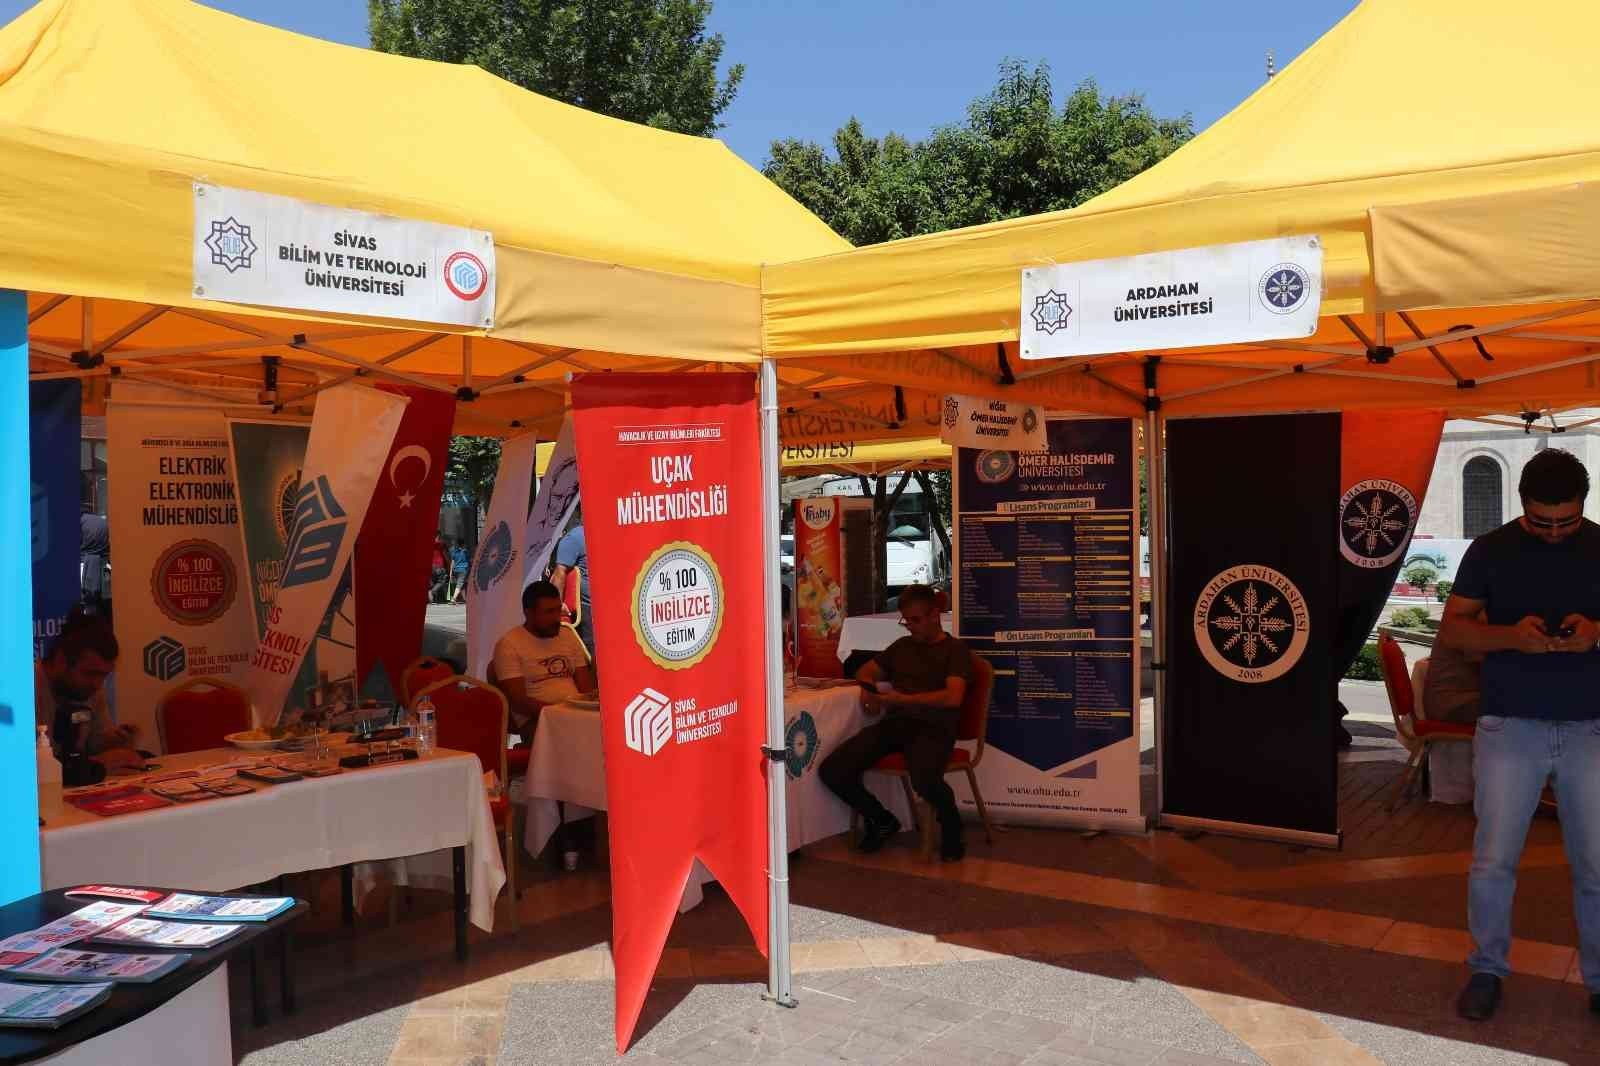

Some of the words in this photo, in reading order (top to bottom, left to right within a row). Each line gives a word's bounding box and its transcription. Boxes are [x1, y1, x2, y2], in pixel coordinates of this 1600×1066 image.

[334, 229, 376, 251] SİVAS
[279, 245, 321, 266] BİLİM
[324, 252, 345, 268] VE
[348, 256, 427, 279] TEKNOLOJİ
[305, 270, 404, 296] ÜNİVERSİTESİ
[1126, 282, 1199, 302] ARDAHAN
[1114, 297, 1213, 322] ÜNİVERSİTESİ
[160, 455, 226, 475] ELEKTRİK
[1050, 453, 1114, 464] HALİSDEMİR
[651, 455, 693, 488] UÇAK
[1019, 465, 1084, 478] ÜNİVERSİTESİ
[150, 480, 235, 500] ELEKTRONİK
[143, 504, 238, 526] MÜHENDİSLİĞ
[617, 484, 727, 525] MÜHENDİSLİĞİ
[194, 558, 212, 572] 100
[168, 576, 224, 593] İNGİLİZCE
[660, 572, 671, 592] %
[676, 568, 697, 589] 100
[651, 595, 711, 624] İNGİLİZCE
[1198, 570, 1237, 629] ARDAHAN
[666, 628, 695, 646] EĞİTİM
[1238, 670, 1264, 680] 2008
[674, 698, 696, 714] SİVAS
[675, 714, 696, 730] BİLİM
[697, 711, 706, 723] VE
[708, 700, 738, 720] TEKNOLOJİ
[676, 720, 722, 744] ÜNİVERSİTESİ
